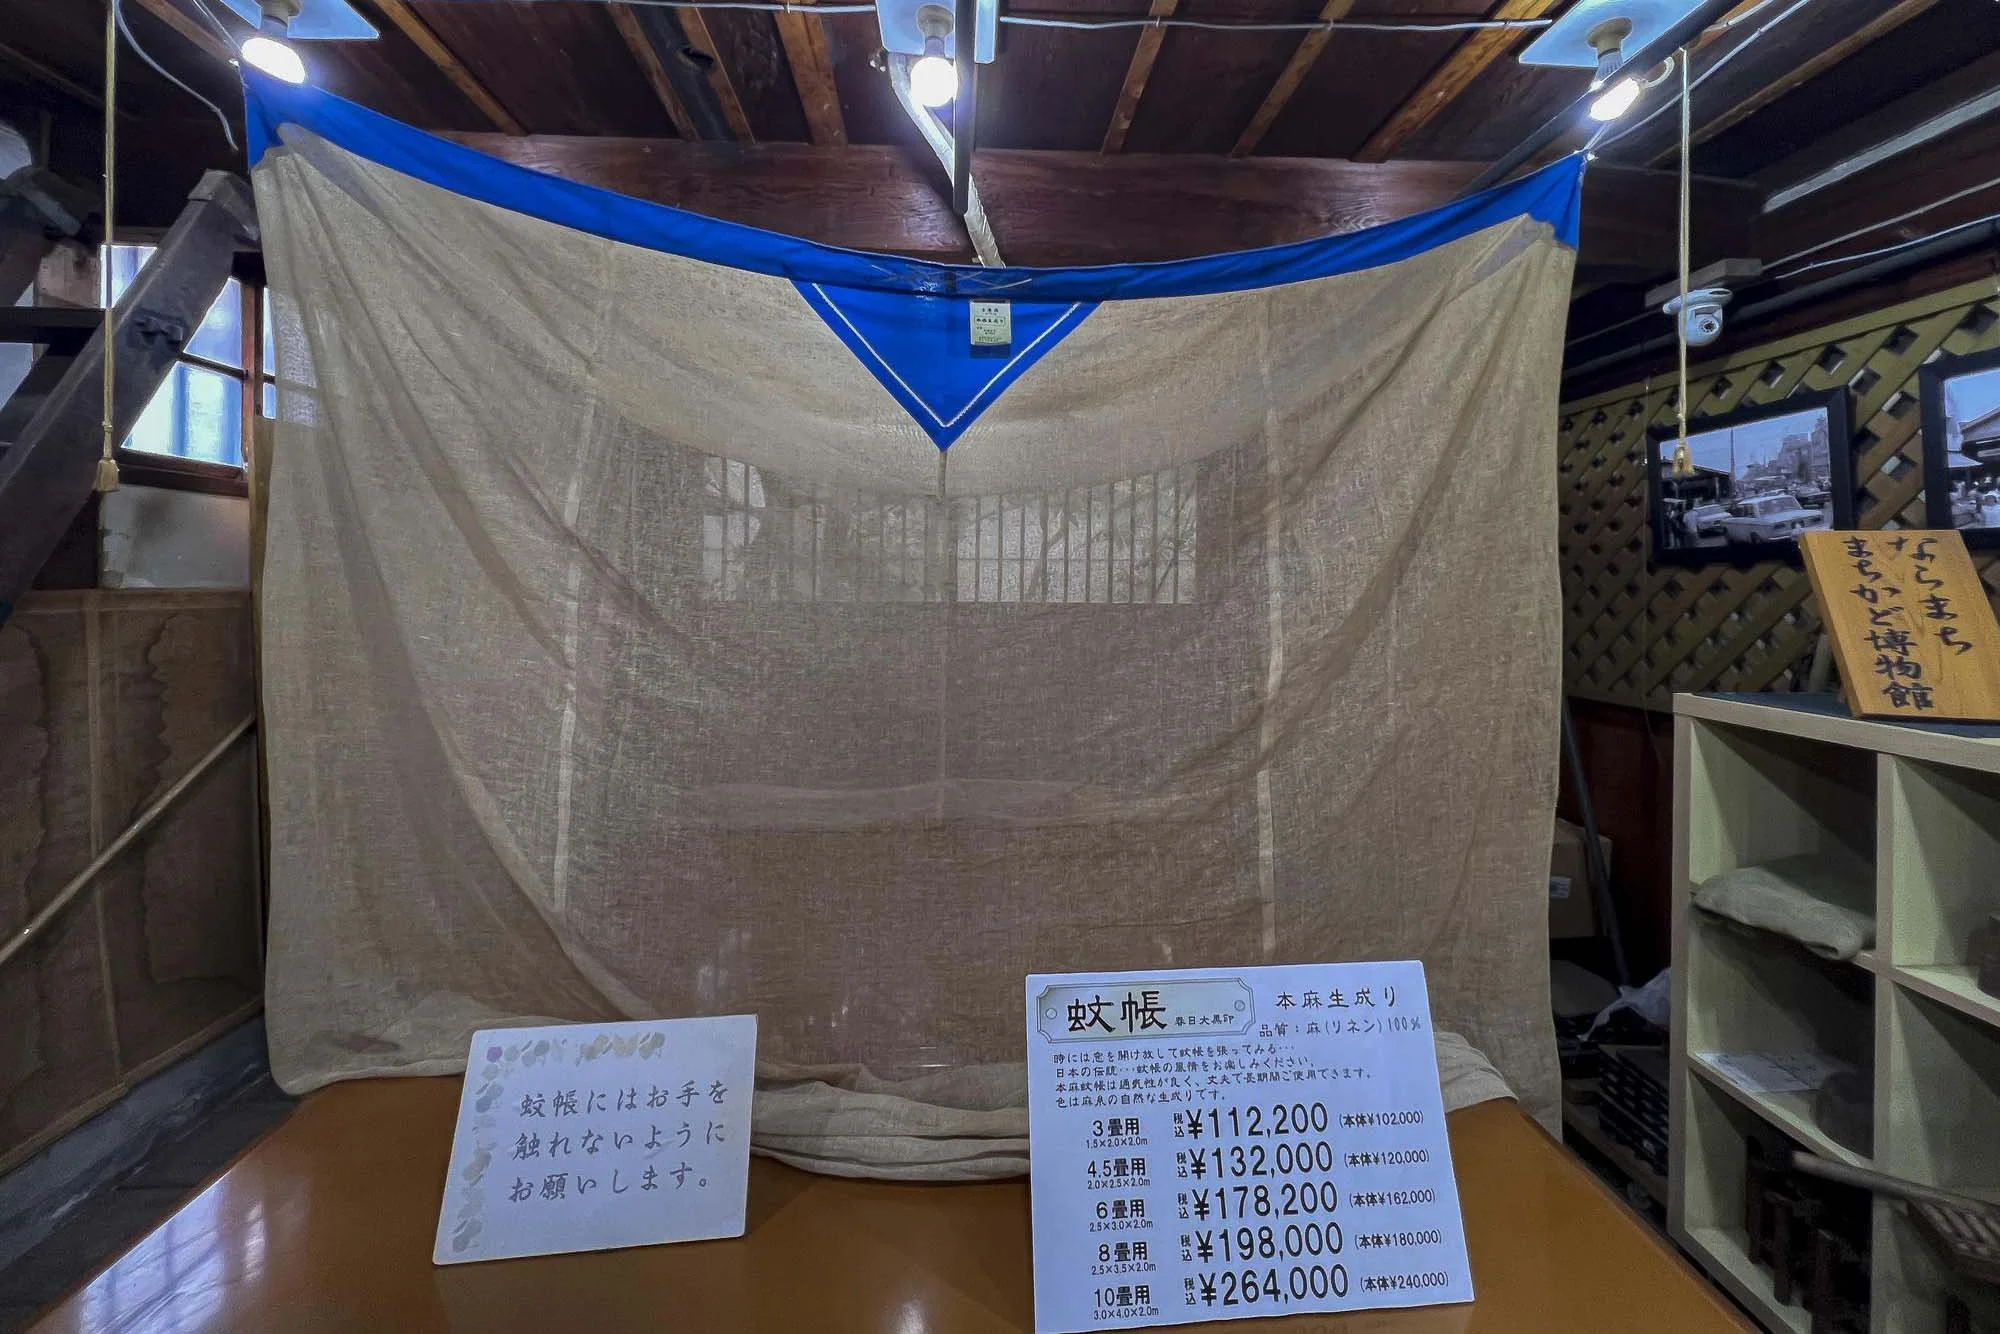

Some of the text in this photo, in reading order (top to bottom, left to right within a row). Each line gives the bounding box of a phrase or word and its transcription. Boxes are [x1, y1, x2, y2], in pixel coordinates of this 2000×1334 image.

[1887, 536, 1973, 655] ならまち
[1842, 536, 1936, 710] まちかど博物館
[1067, 990, 1167, 1034] 蚊帳
[1275, 986, 1396, 1010] 本麻生成り
[519, 1079, 728, 1118] 蚊帳にはお手を
[1092, 1117, 1140, 1137] 3畳用
[1173, 1112, 1185, 1138] 税込
[1186, 1101, 1328, 1140] ¥112,200
[512, 1121, 725, 1161] 触れないように
[1087, 1158, 1146, 1178] 4.5畳用
[1176, 1152, 1188, 1178] 税込
[1188, 1141, 1333, 1180] ¥132,000
[508, 1162, 707, 1203] お願いします。
[1096, 1199, 1145, 1219] 6畳用
[1177, 1192, 1189, 1219] 税込
[1192, 1181, 1338, 1220] ¥178,200
[1098, 1241, 1148, 1262] 8畳用
[1180, 1234, 1192, 1261] 税込
[1195, 1222, 1343, 1263] ¥198,000
[1094, 1285, 1151, 1308] 10畳用
[1184, 1277, 1196, 1305] 税込
[1199, 1263, 1349, 1307] ¥264,000
